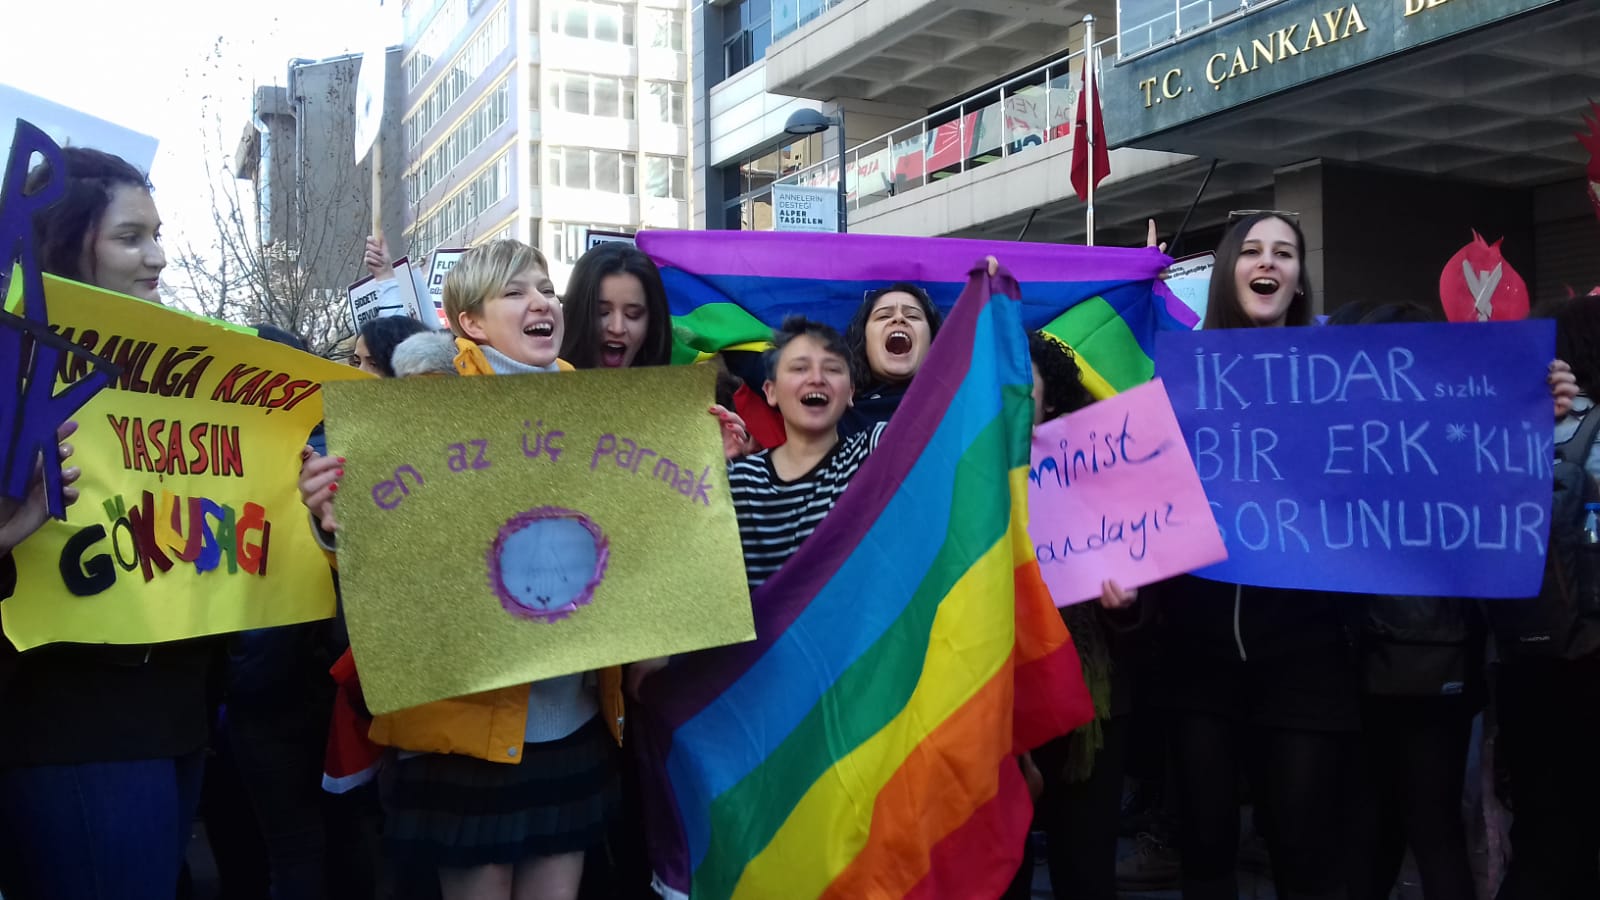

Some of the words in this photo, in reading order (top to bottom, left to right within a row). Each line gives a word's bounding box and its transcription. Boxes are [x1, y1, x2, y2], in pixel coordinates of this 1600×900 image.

[1139, 68, 1193, 108] T.C.
[1206, 2, 1368, 91] ÇANKAYA
[780, 209, 807, 217] ALPER
[780, 216, 823, 225] TAŞDELEN
[211, 363, 322, 414] KARŞI
[1195, 346, 1427, 411] İKTİDAR
[1434, 375, 1497, 397] sızlık
[106, 413, 243, 483] YAŞASIN
[371, 463, 424, 510] en
[447, 438, 492, 473] az
[521, 420, 566, 462] üç
[590, 432, 713, 506] parmak
[1194, 421, 1285, 482] BİR
